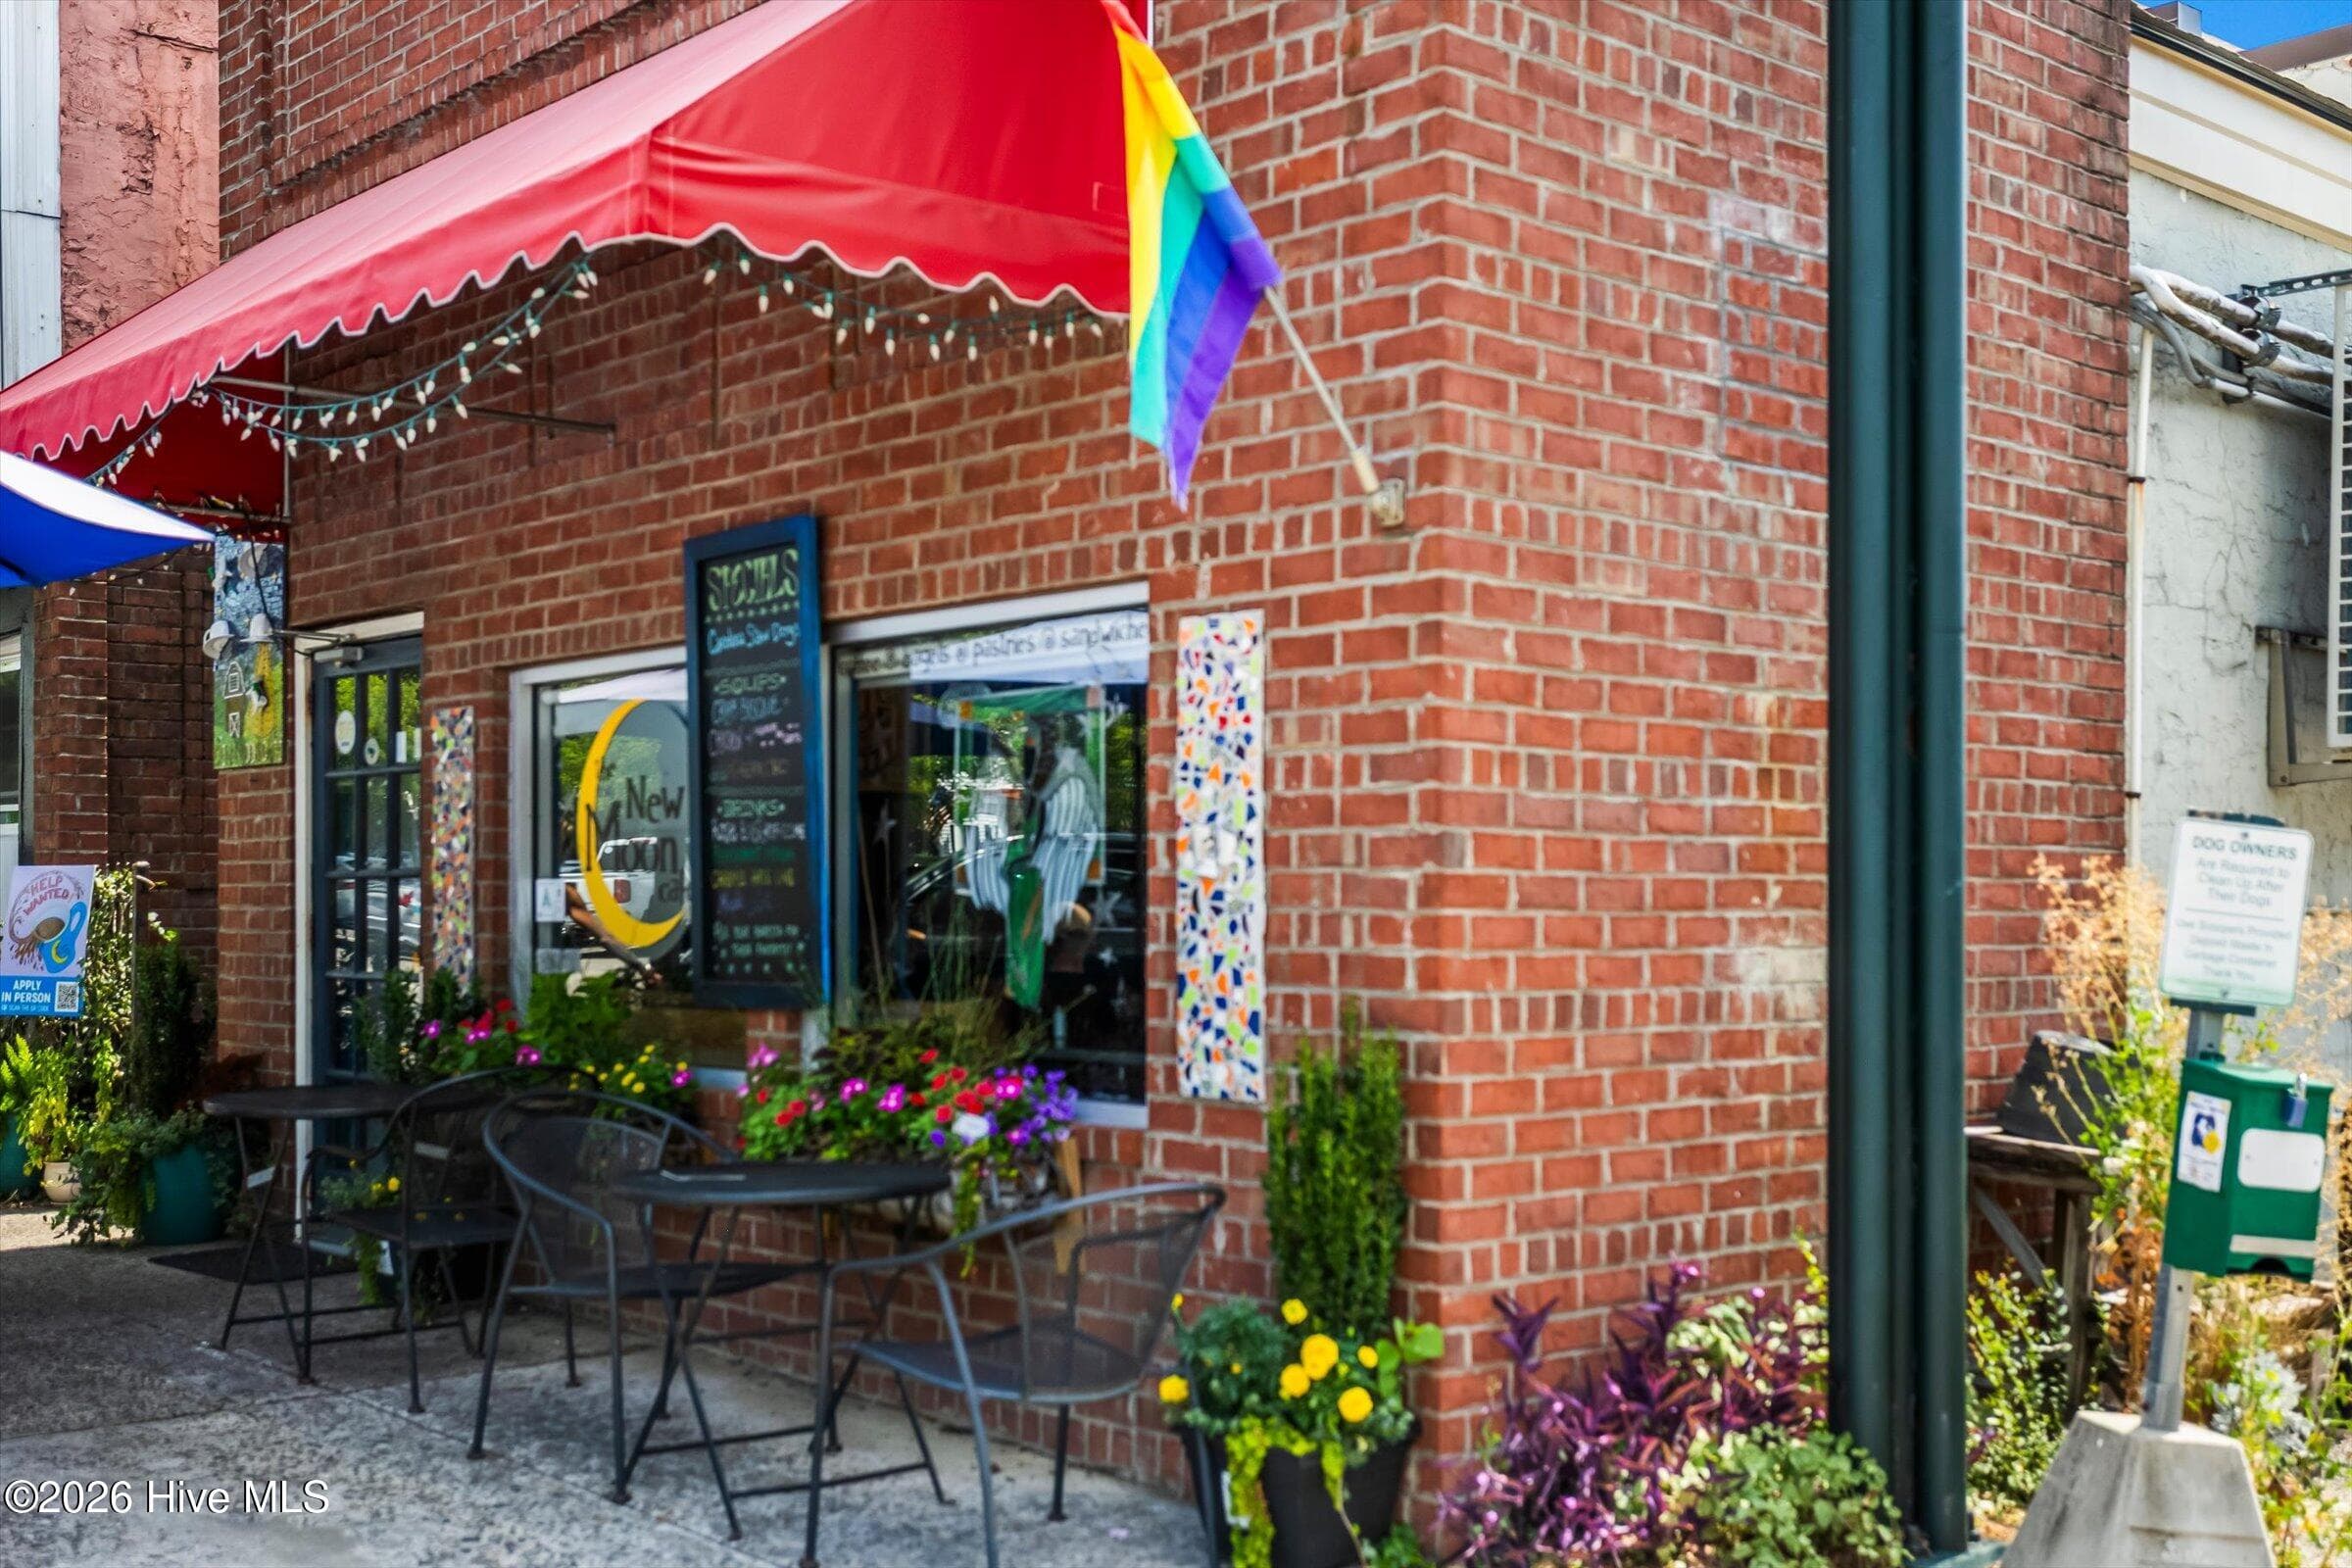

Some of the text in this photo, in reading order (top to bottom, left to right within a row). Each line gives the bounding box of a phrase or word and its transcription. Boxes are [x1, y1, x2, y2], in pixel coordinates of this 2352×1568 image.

[1060, 617, 1147, 649] sandwiche
[624, 775, 686, 824] New
[585, 801, 678, 875] Moon
[2192, 835, 2297, 860] DOG OWNERS
[30, 874, 63, 895] HELP
[1, 992, 51, 1004] IN PERSON
[13, 980, 42, 991] APPLY
